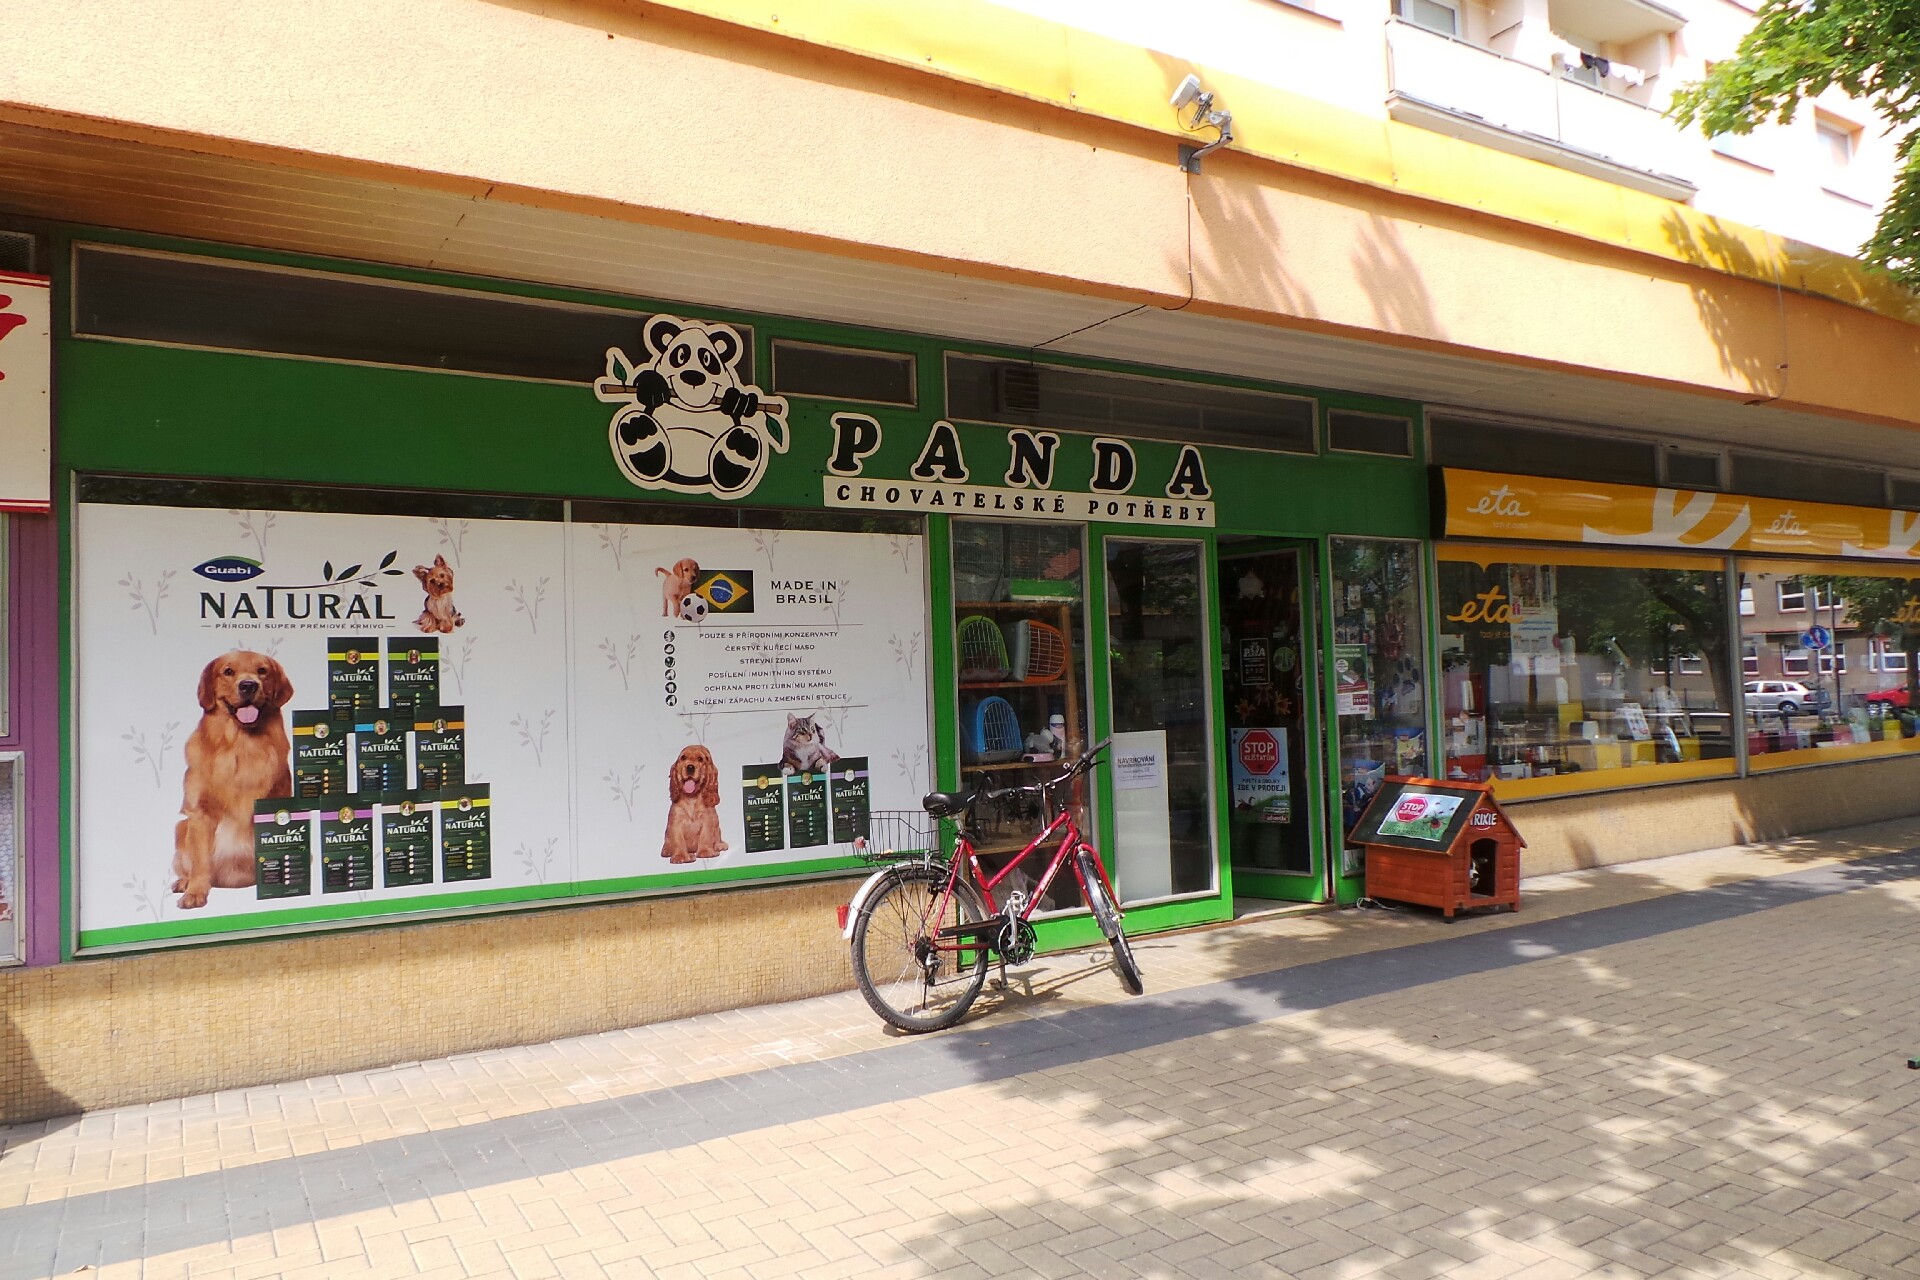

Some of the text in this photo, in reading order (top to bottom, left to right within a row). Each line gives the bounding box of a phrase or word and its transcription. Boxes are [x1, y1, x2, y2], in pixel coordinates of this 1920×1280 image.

[830, 415, 1210, 498] PANDA
[837, 484, 1207, 522] CHOVATELSKÉ POTŘEBY
[1466, 484, 1531, 517] eta
[1764, 510, 1809, 536] eta
[204, 564, 252, 576] Guabi
[770, 580, 837, 591] MADE IN
[200, 585, 396, 619] NATURAL
[776, 593, 833, 604] BRASIL
[1446, 584, 1523, 623] eta
[736, 631, 783, 639] PŘÍRODNÍMI
[775, 656, 803, 664] ZDRAVÍ
[332, 673, 374, 682] NATURAL
[393, 672, 434, 682] NATURAL
[797, 668, 832, 676] SYSTÉMU
[704, 684, 743, 692] OCHRANA
[770, 681, 806, 690] ZUBNÍMU
[816, 693, 847, 701] STOLICE
[361, 743, 401, 753] NATURAL
[420, 742, 460, 752] NATURAL
[1244, 742, 1274, 753] STOP
[299, 747, 343, 759] NATURAL
[835, 789, 865, 798] NATURAL
[1257, 784, 1286, 792] PRODEJI
[748, 796, 779, 806] NATURAL
[792, 792, 823, 802] NATURAL
[1402, 802, 1424, 811] STOP
[387, 824, 428, 836] NATURAL
[445, 819, 485, 831] NATURAL
[260, 833, 304, 845] NATURAL
[325, 832, 368, 844] NATURAL
